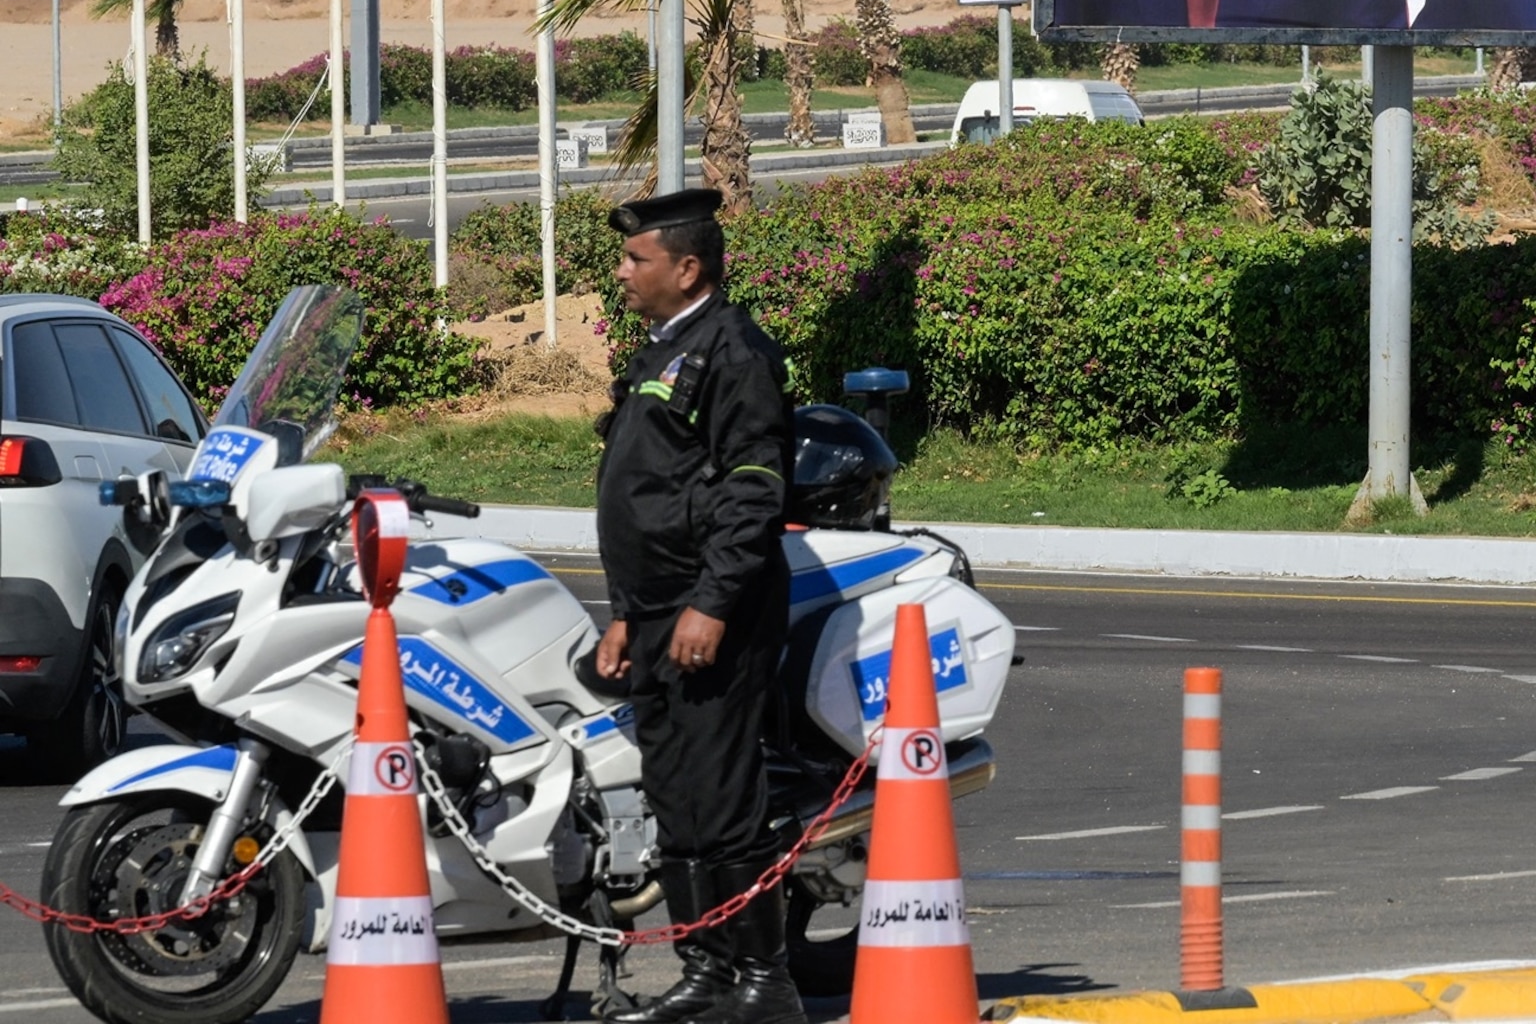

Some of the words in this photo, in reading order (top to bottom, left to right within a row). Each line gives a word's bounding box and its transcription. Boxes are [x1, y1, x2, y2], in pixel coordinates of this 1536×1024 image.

[398, 647, 446, 688] المرو
[442, 672, 504, 728] شرطة
[867, 901, 909, 928] للمرور
[914, 900, 953, 923] العامة
[341, 914, 387, 940] للمرور
